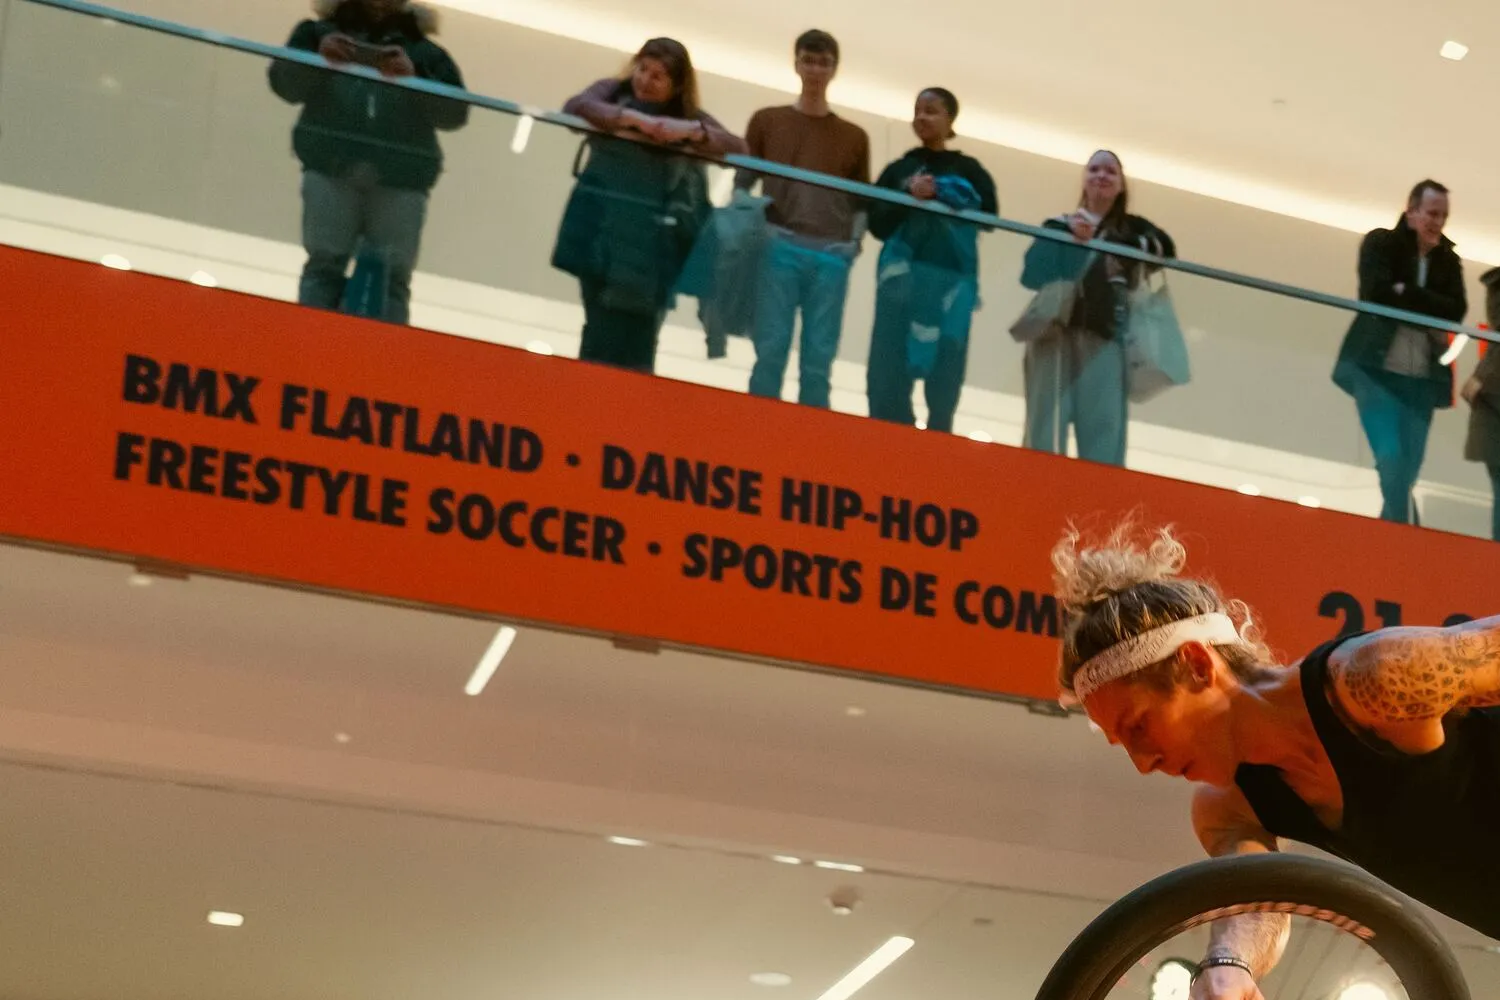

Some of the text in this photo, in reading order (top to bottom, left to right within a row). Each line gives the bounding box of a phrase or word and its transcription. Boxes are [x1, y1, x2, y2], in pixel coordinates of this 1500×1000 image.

[113, 431, 409, 528] FREESTYLE
[426, 487, 626, 564] SOCCER
[681, 532, 862, 604] SPORTS
[880, 566, 938, 618] DE
[121, 353, 978, 552] BMX FLATLAND DANSE HIP-HOP
